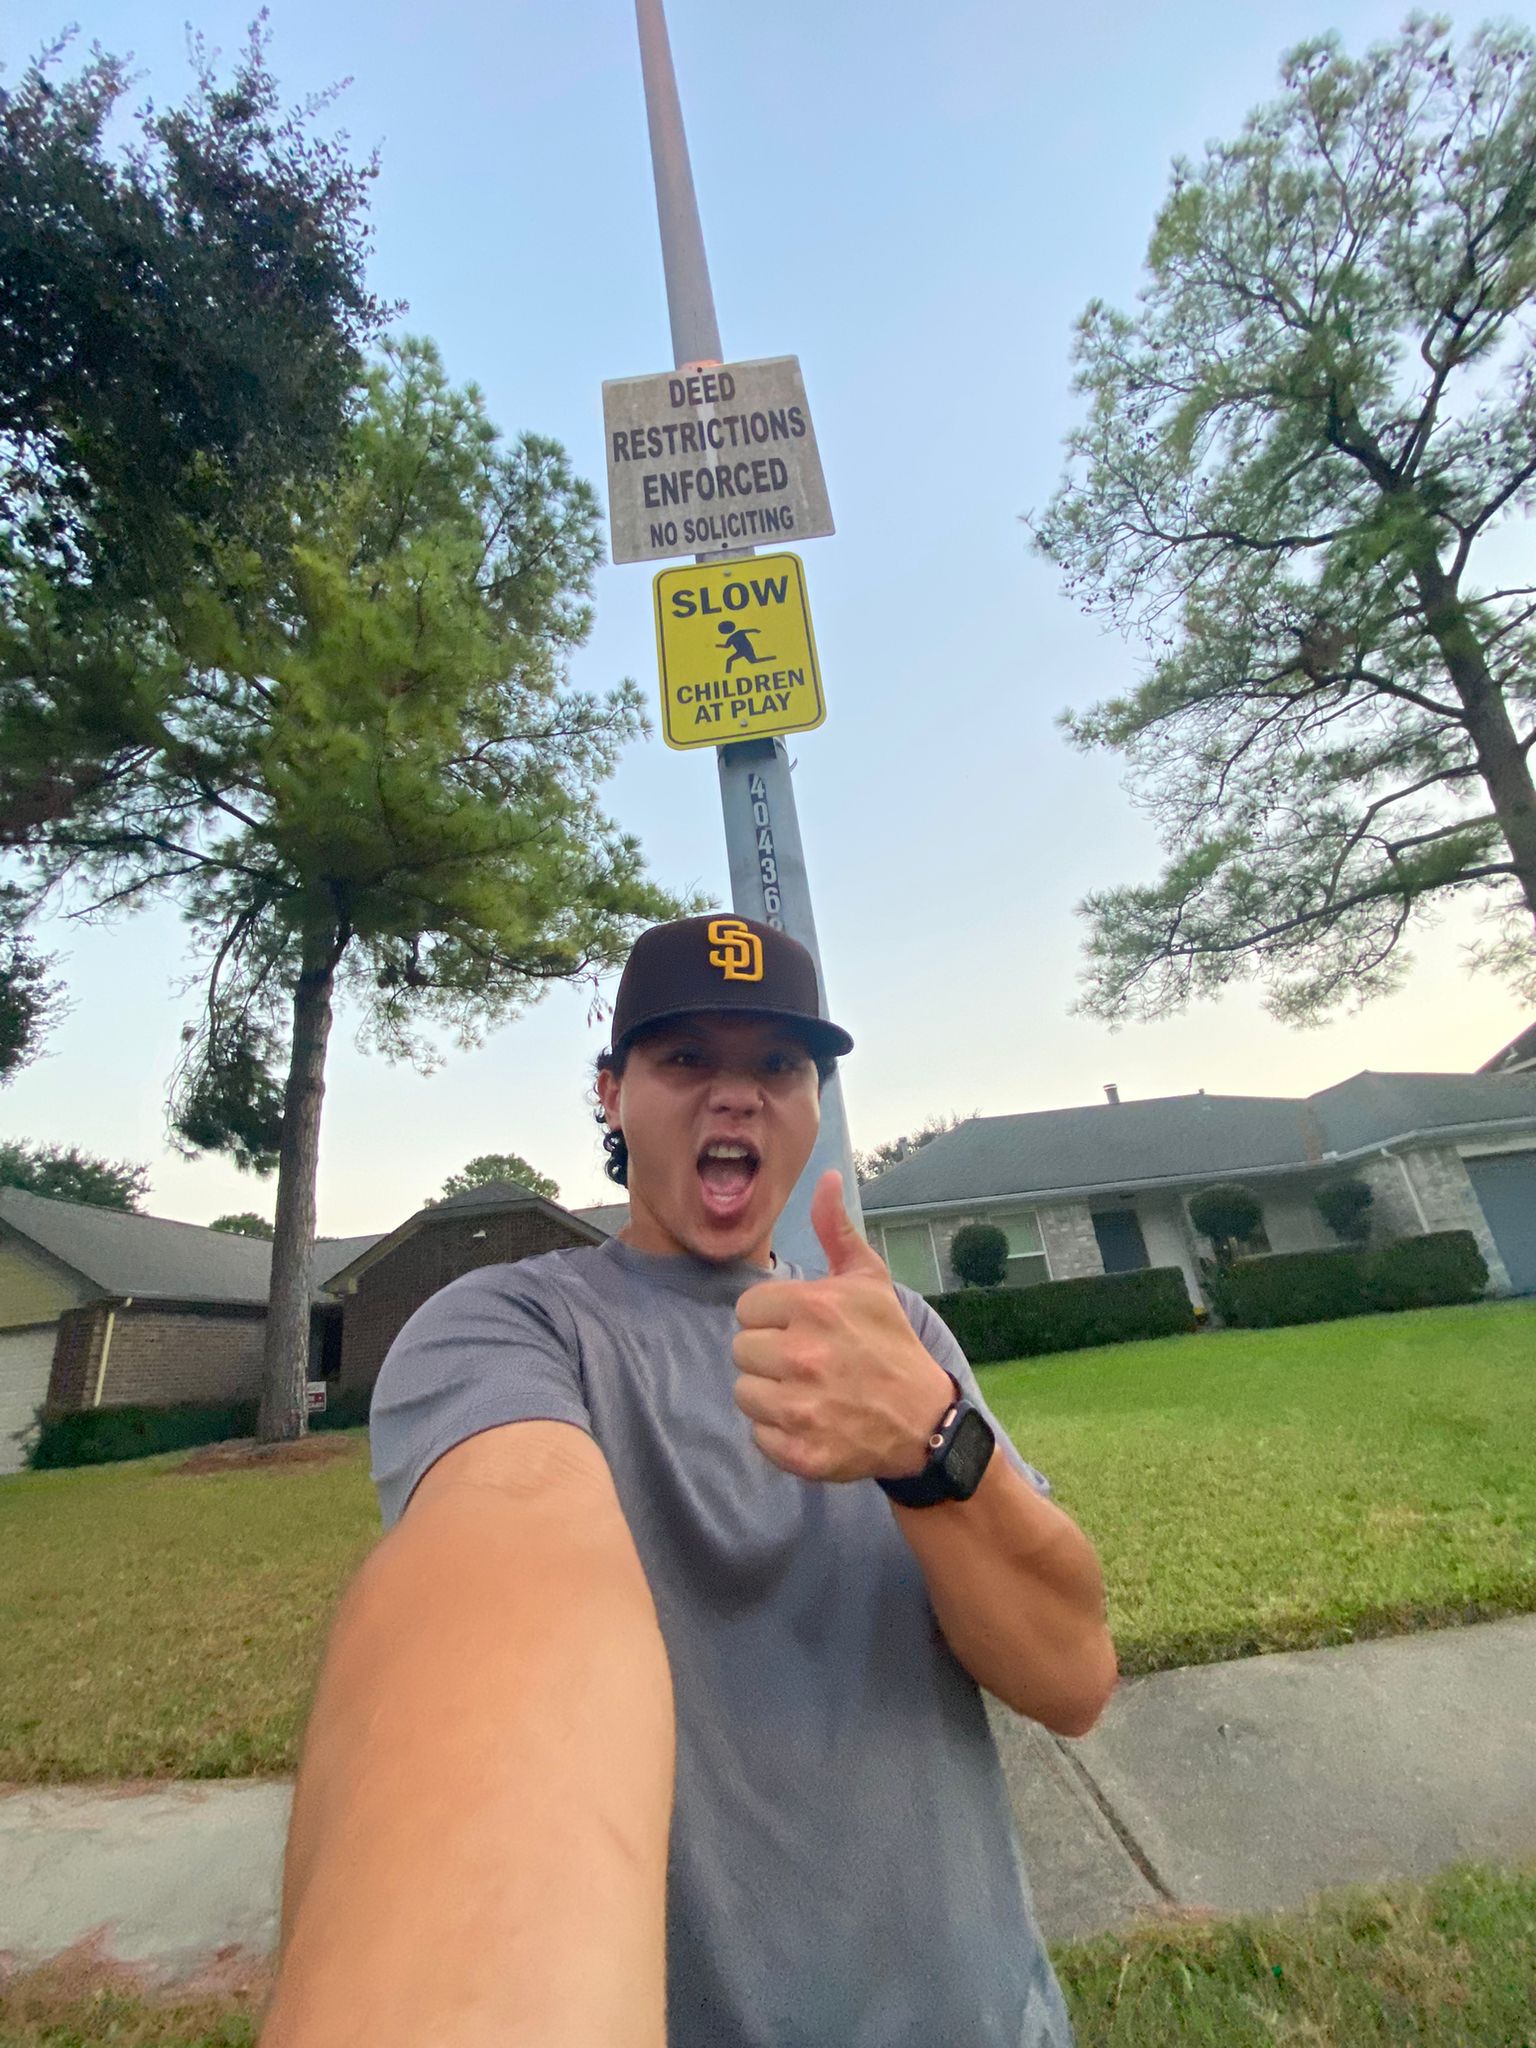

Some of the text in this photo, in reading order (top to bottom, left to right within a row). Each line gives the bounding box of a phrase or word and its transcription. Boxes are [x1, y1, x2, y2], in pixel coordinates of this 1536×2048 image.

[669, 372, 736, 408] DEED
[612, 406, 806, 462] RESTRICTIONS
[643, 457, 788, 508] ENFORCED
[650, 505, 794, 548] NO SOLICITING
[672, 575, 788, 618] SLOW
[677, 668, 805, 704] CHILDREN
[694, 691, 792, 725] AT PLAY
[708, 920, 764, 982] SD
